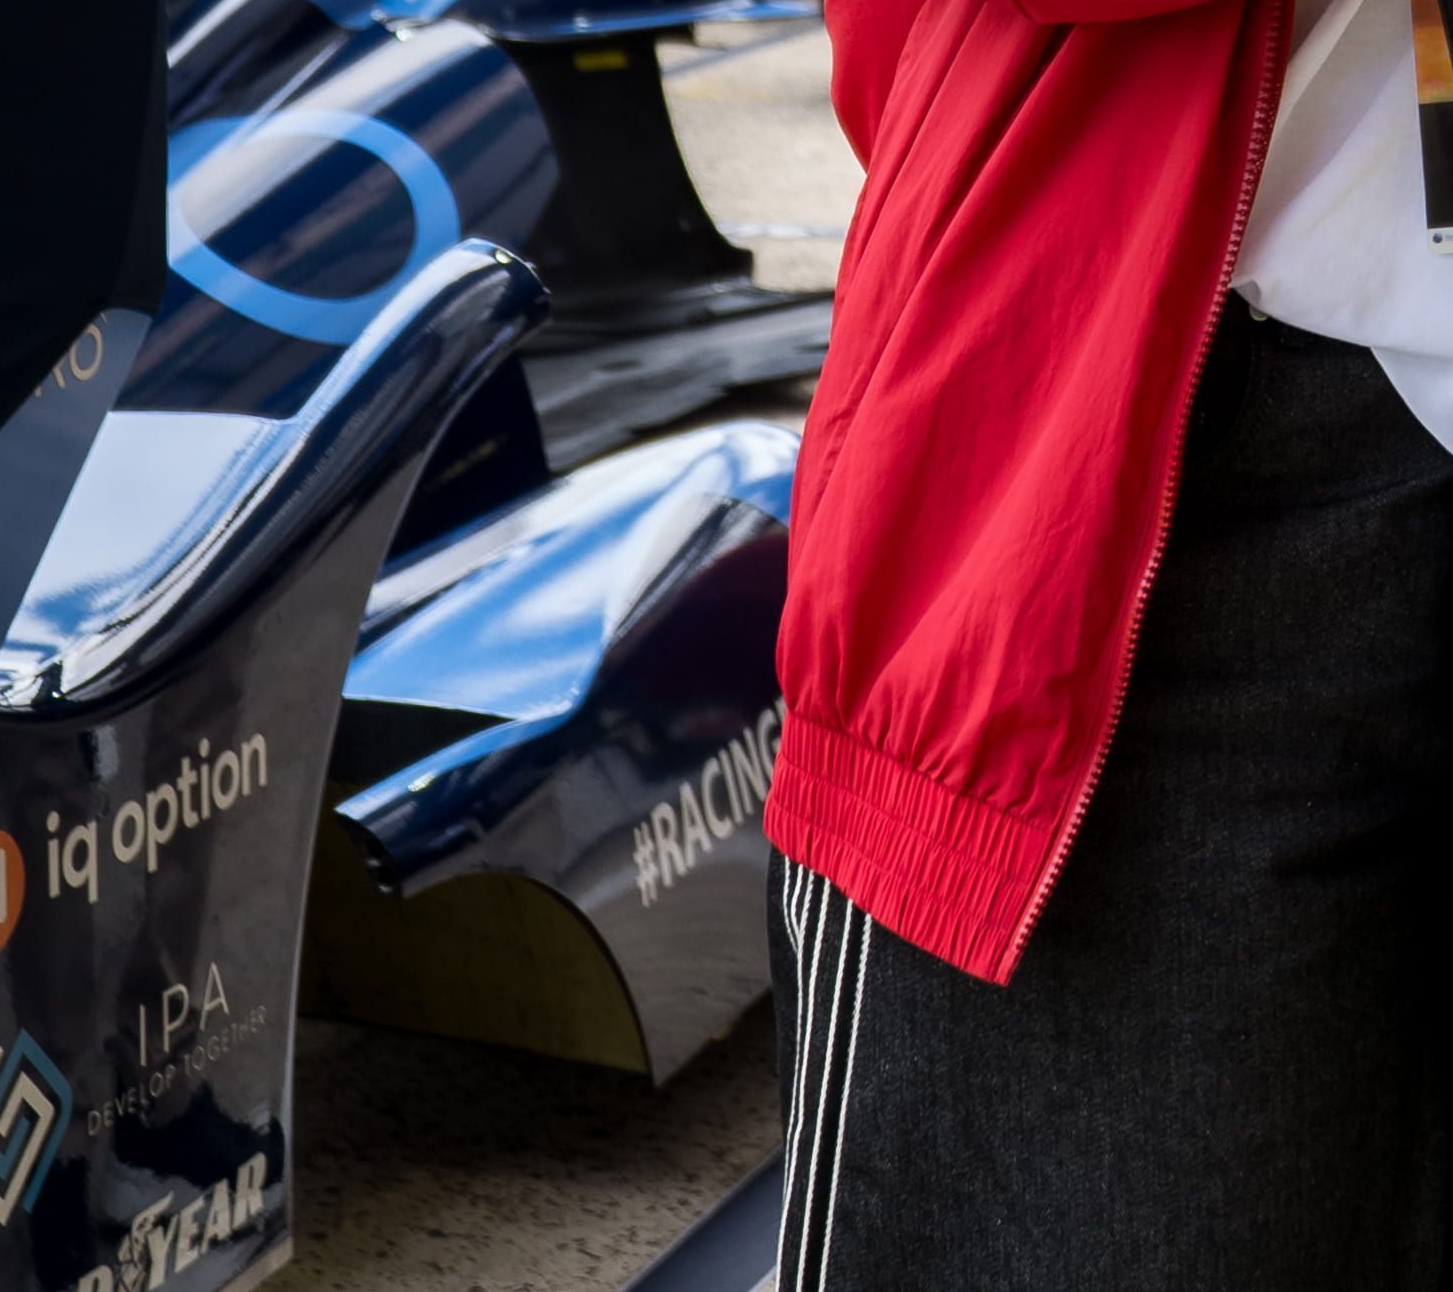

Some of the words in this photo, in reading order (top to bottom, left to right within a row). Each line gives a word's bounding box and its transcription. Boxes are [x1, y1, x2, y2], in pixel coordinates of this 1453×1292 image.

[48, 809, 97, 904] iq
[112, 732, 267, 873] option
[632, 697, 787, 907] #RACING
[87, 1063, 176, 1137] DEVELOP
[184, 1004, 268, 1077] TOGETHER
[137, 961, 230, 1068] IPA
